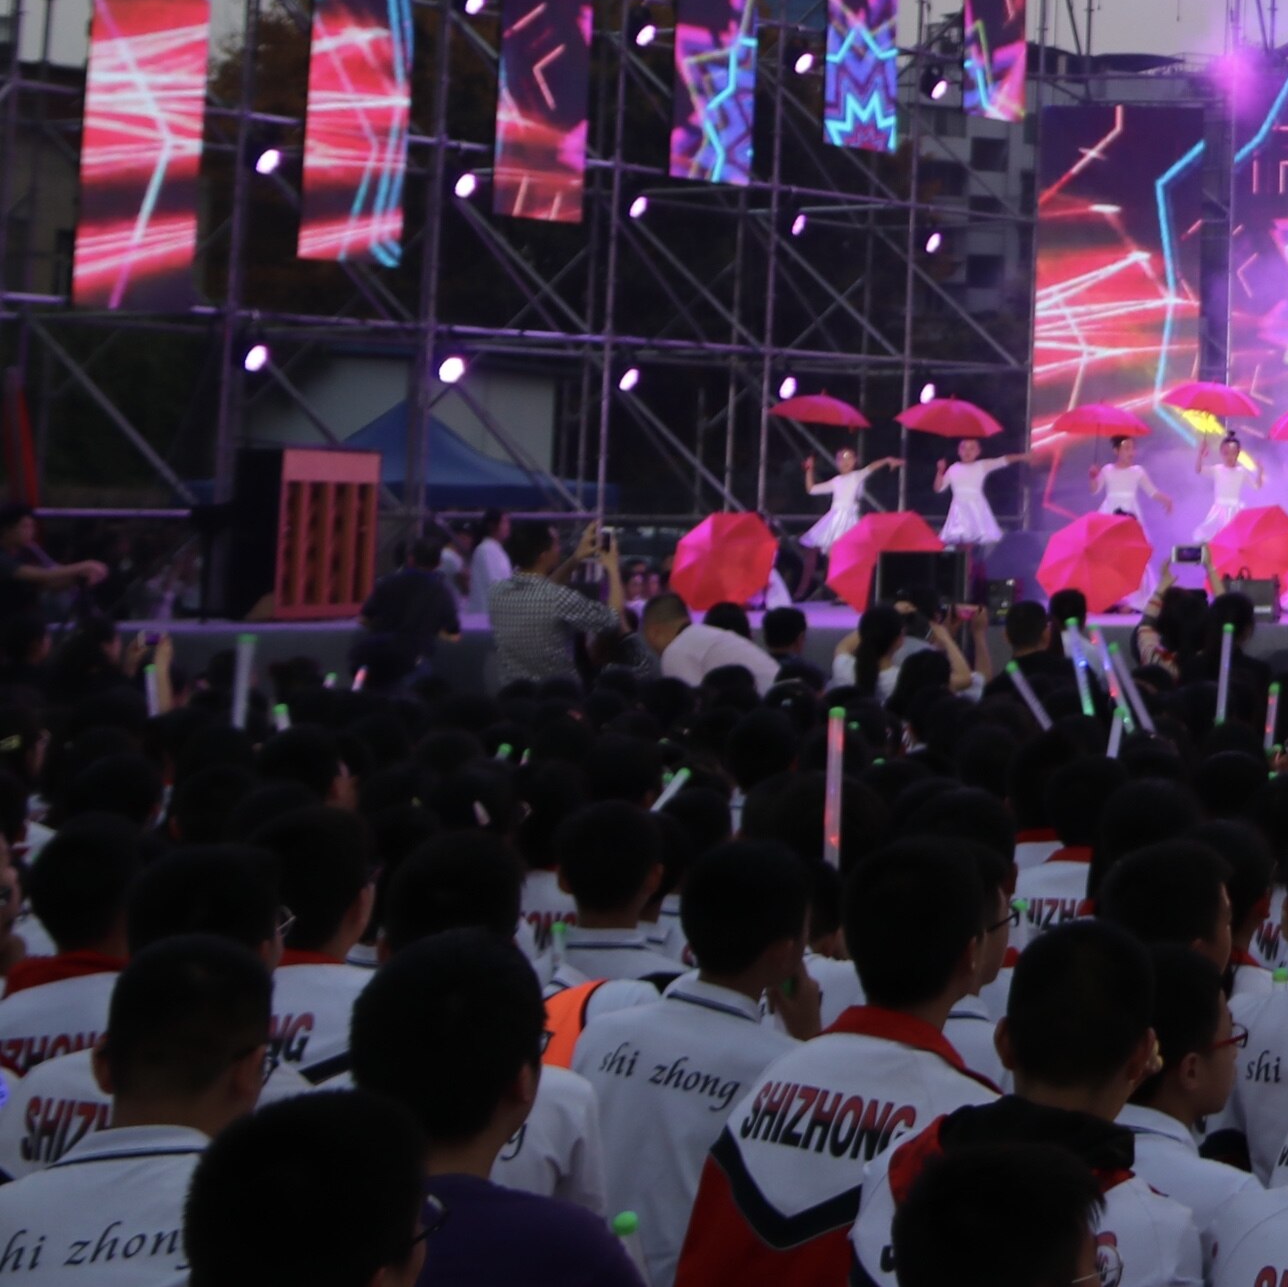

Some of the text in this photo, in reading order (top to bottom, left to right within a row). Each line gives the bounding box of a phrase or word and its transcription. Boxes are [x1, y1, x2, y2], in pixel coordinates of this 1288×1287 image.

[599, 1042, 740, 1111] shi zhong
[1246, 1049, 1281, 1083] shi
[740, 1080, 916, 1161] SHIZHONG
[0, 1220, 192, 1272] hi zhon
